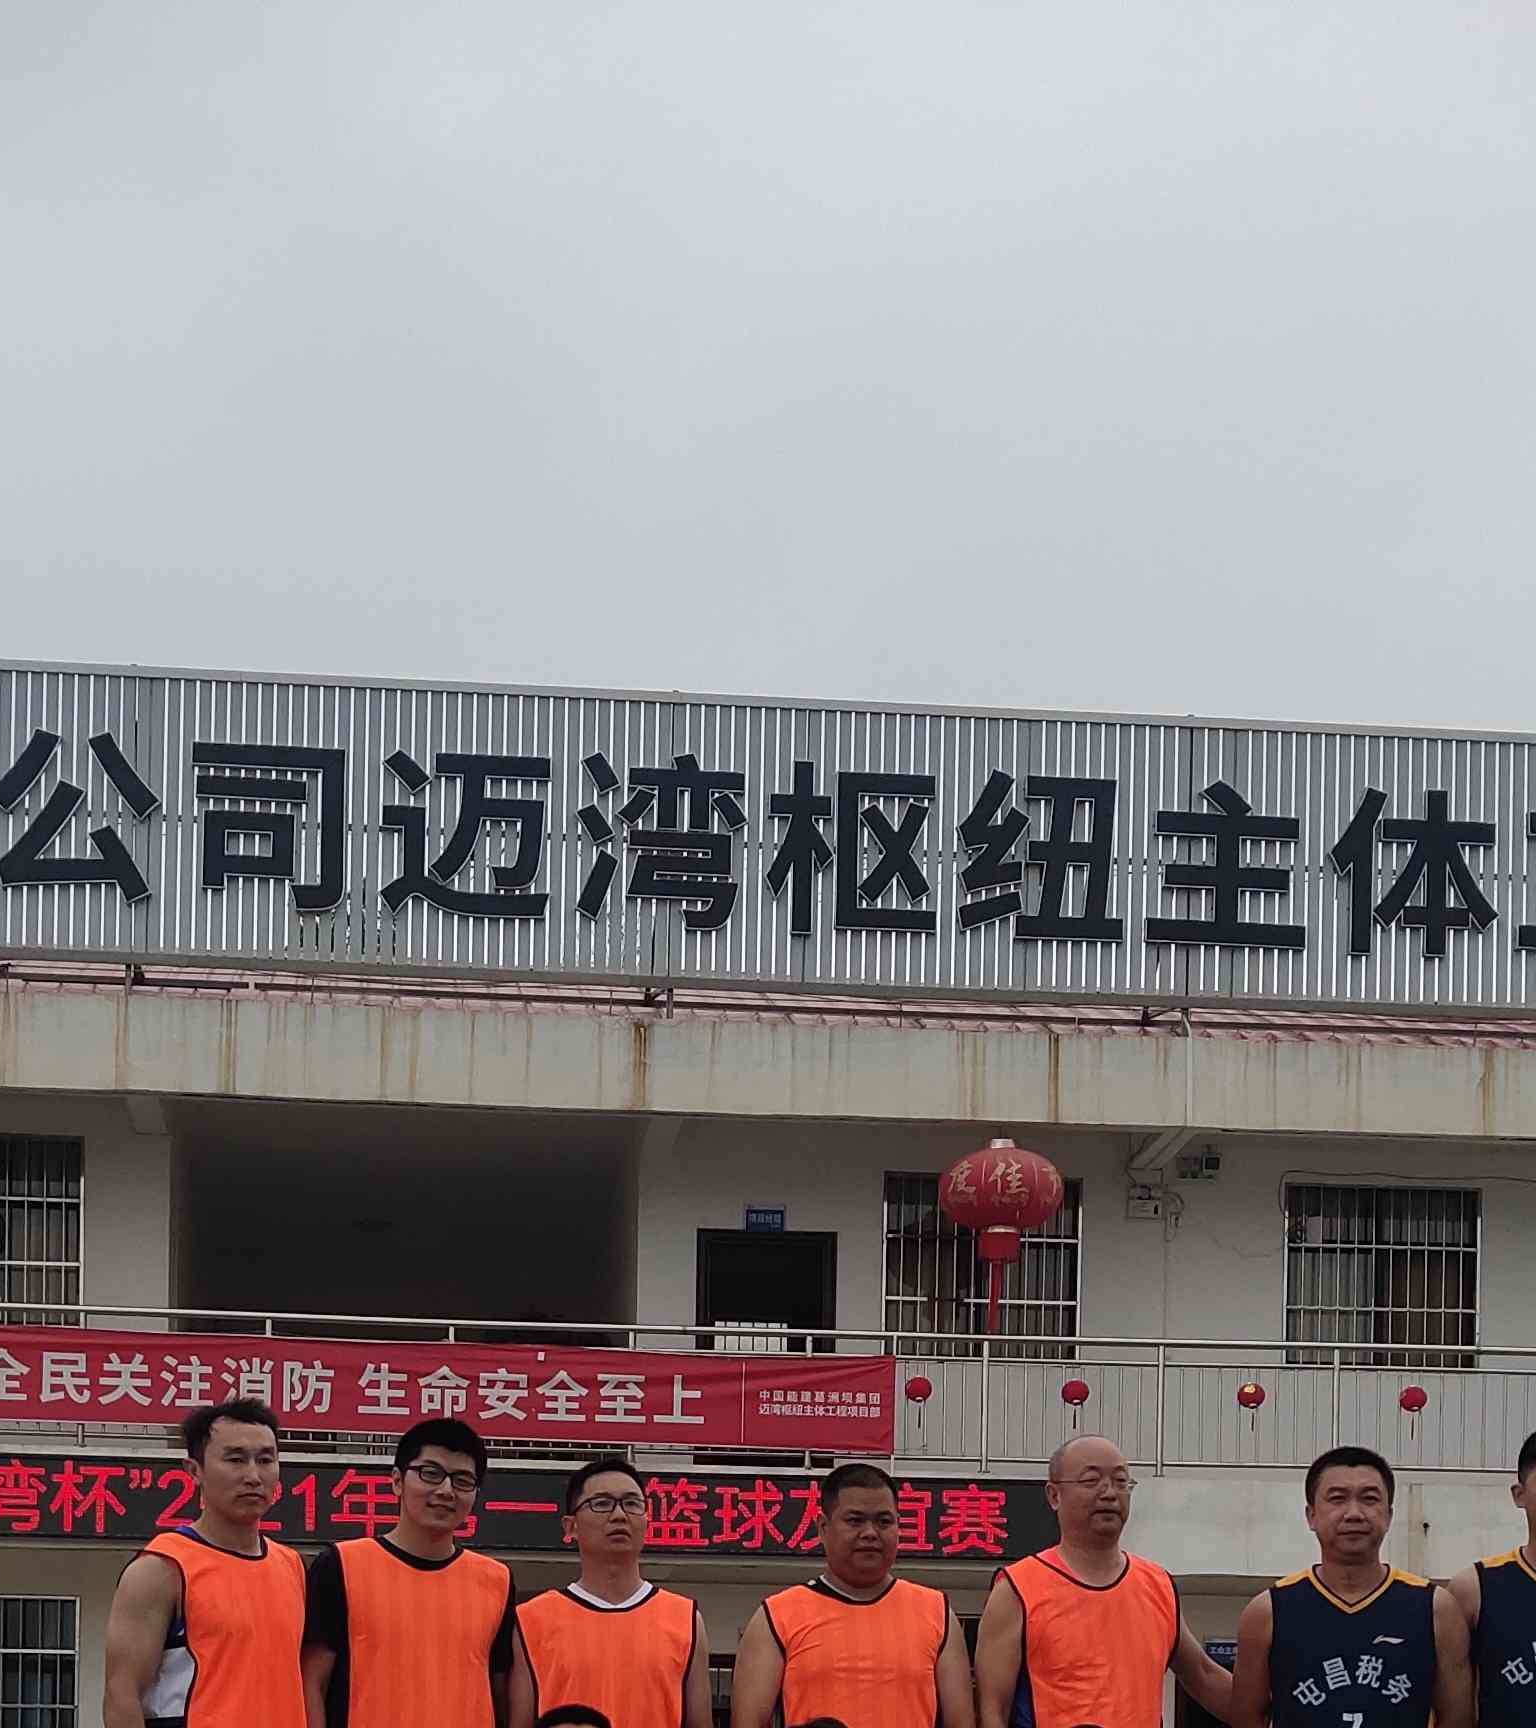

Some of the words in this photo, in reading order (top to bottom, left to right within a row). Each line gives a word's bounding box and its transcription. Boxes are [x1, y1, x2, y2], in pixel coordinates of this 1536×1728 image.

[356, 1362, 705, 1425] 生命安全至上
[1291, 1653, 1414, 1706] 屯昌税务
